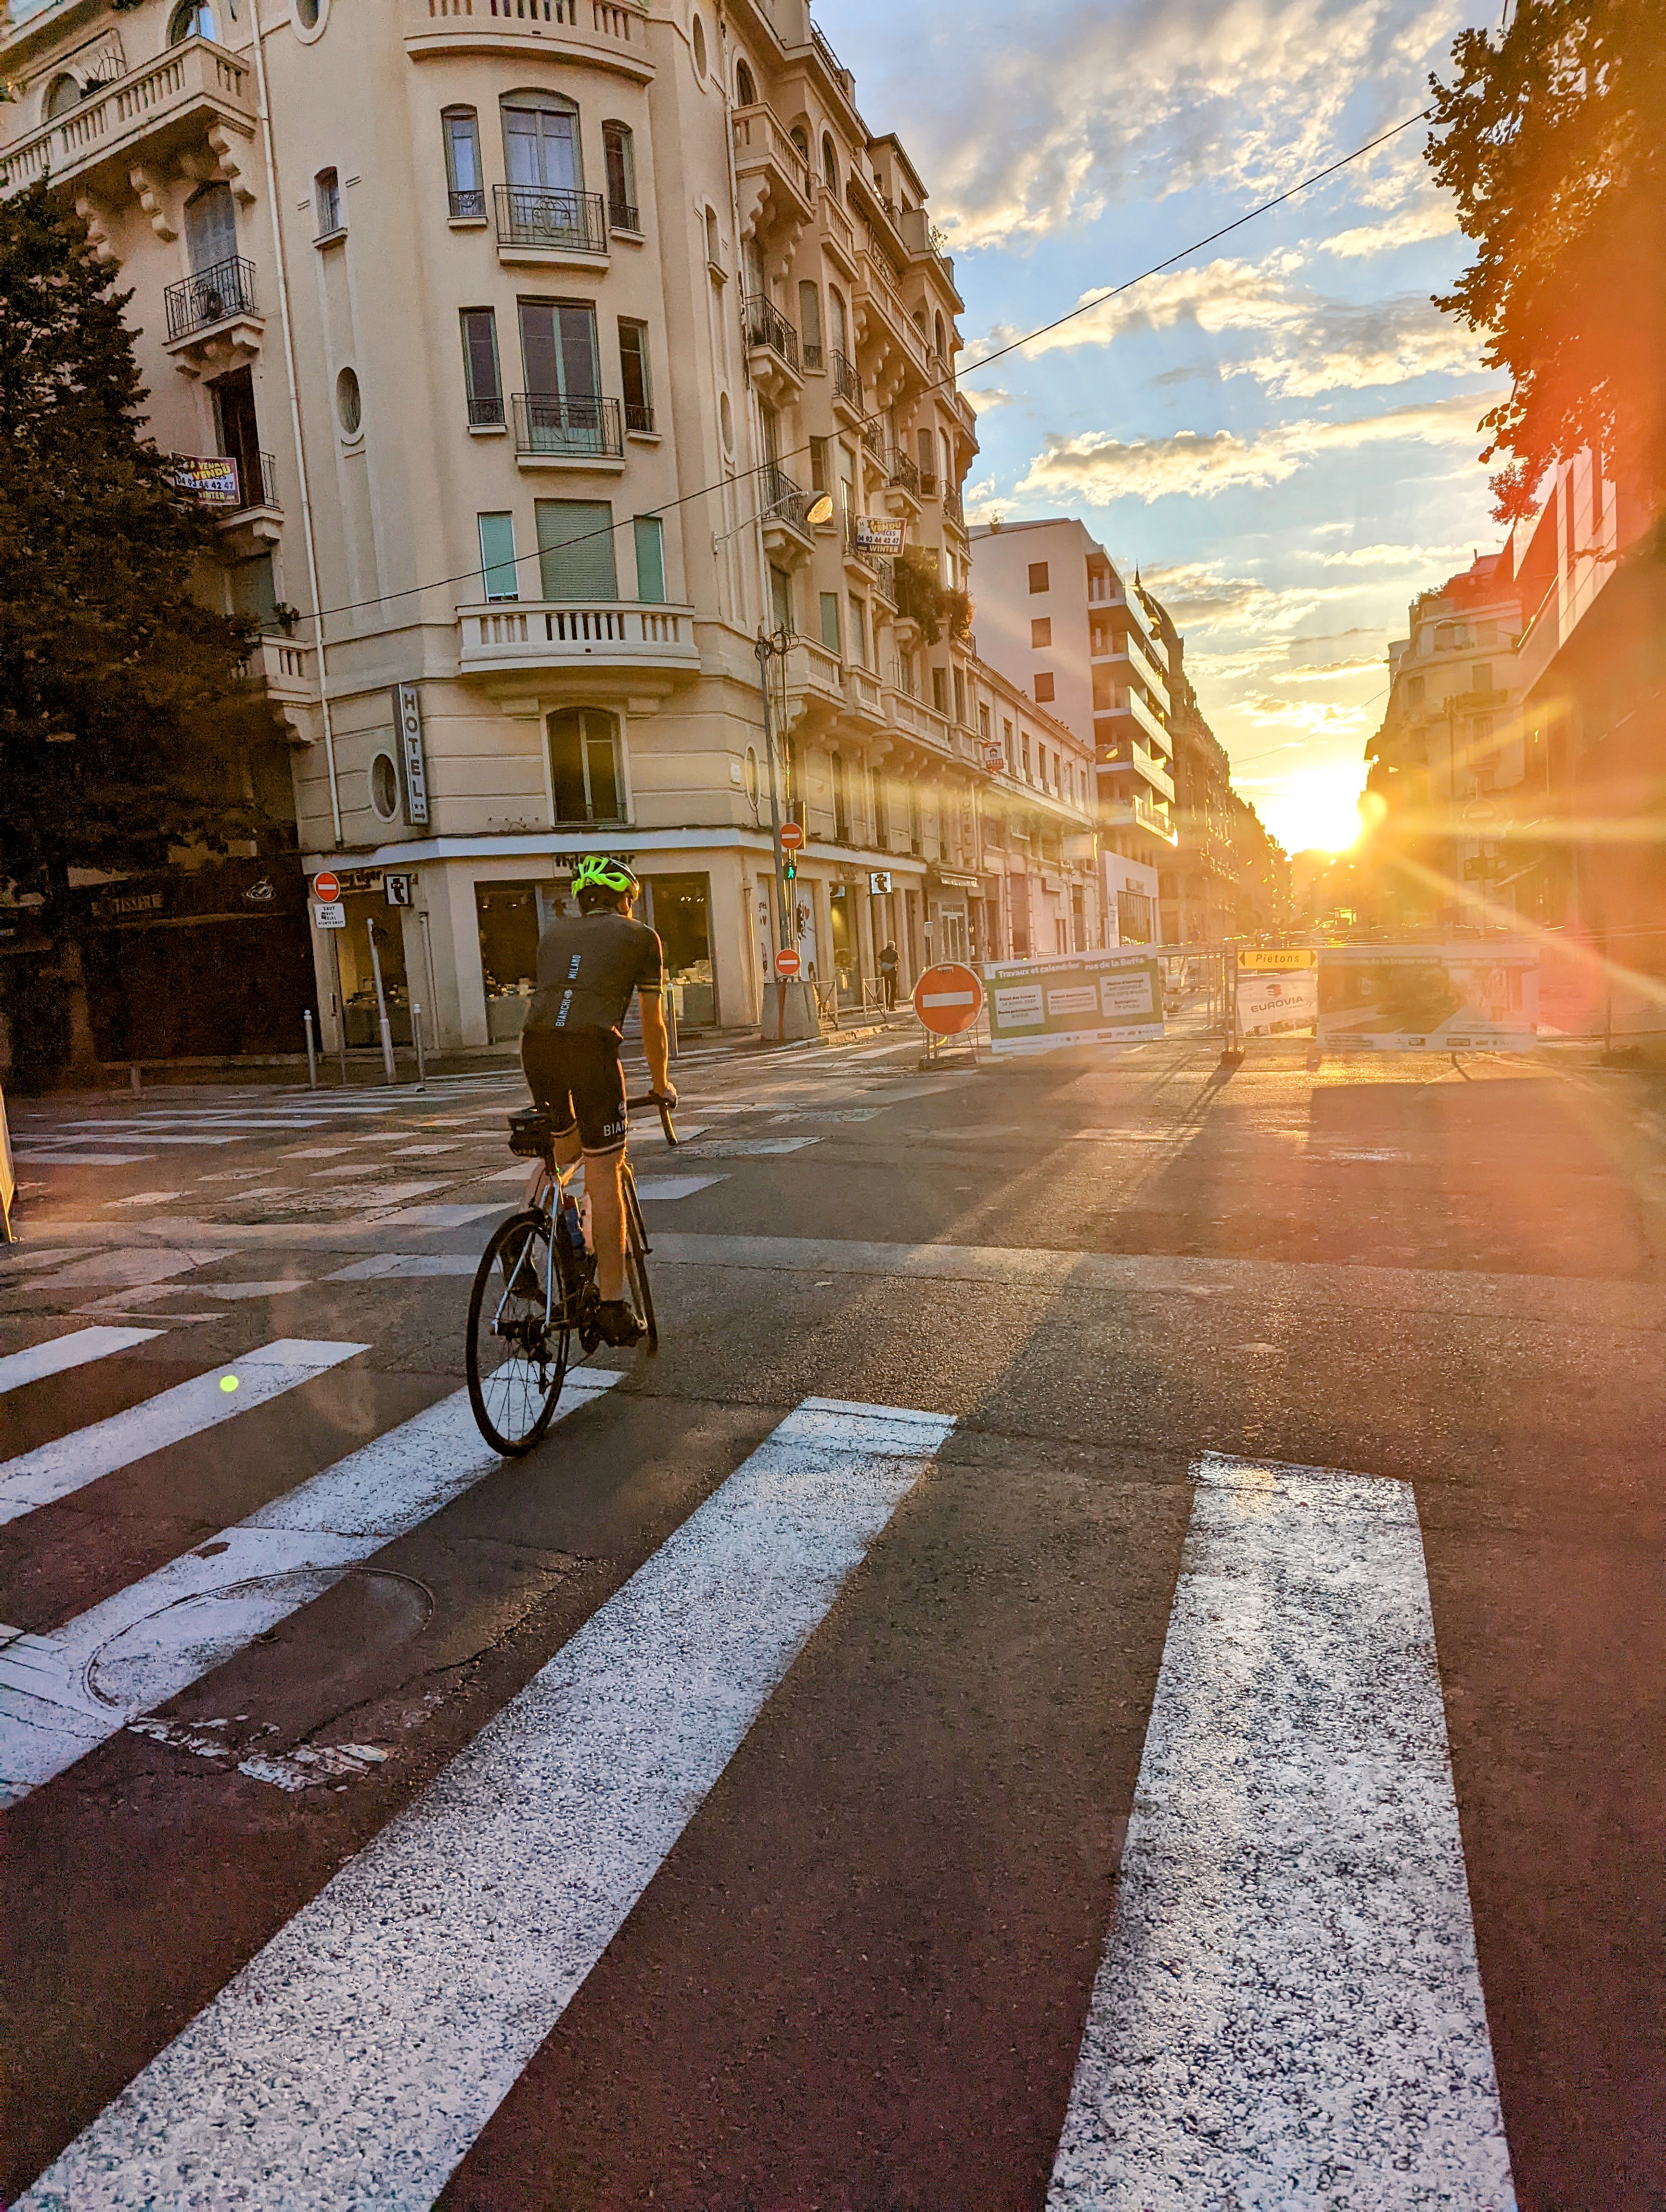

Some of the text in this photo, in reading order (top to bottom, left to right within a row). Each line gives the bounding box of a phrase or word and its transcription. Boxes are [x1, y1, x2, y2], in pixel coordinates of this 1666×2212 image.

[193, 465, 232, 480] VENDU
[212, 481, 222, 489] 42
[224, 481, 234, 489] 47
[870, 522, 901, 532] VENDU
[869, 544, 898, 552] WINTER
[403, 693, 423, 798] HOTEL
[1255, 954, 1300, 963] Piétons
[998, 968, 1030, 978] Travaux
[1100, 960, 1110, 968] de
[555, 955, 582, 1027] BIANCHI MILANO
[1251, 996, 1304, 1013] EUROVIA
[603, 1120, 625, 1137] BIA
